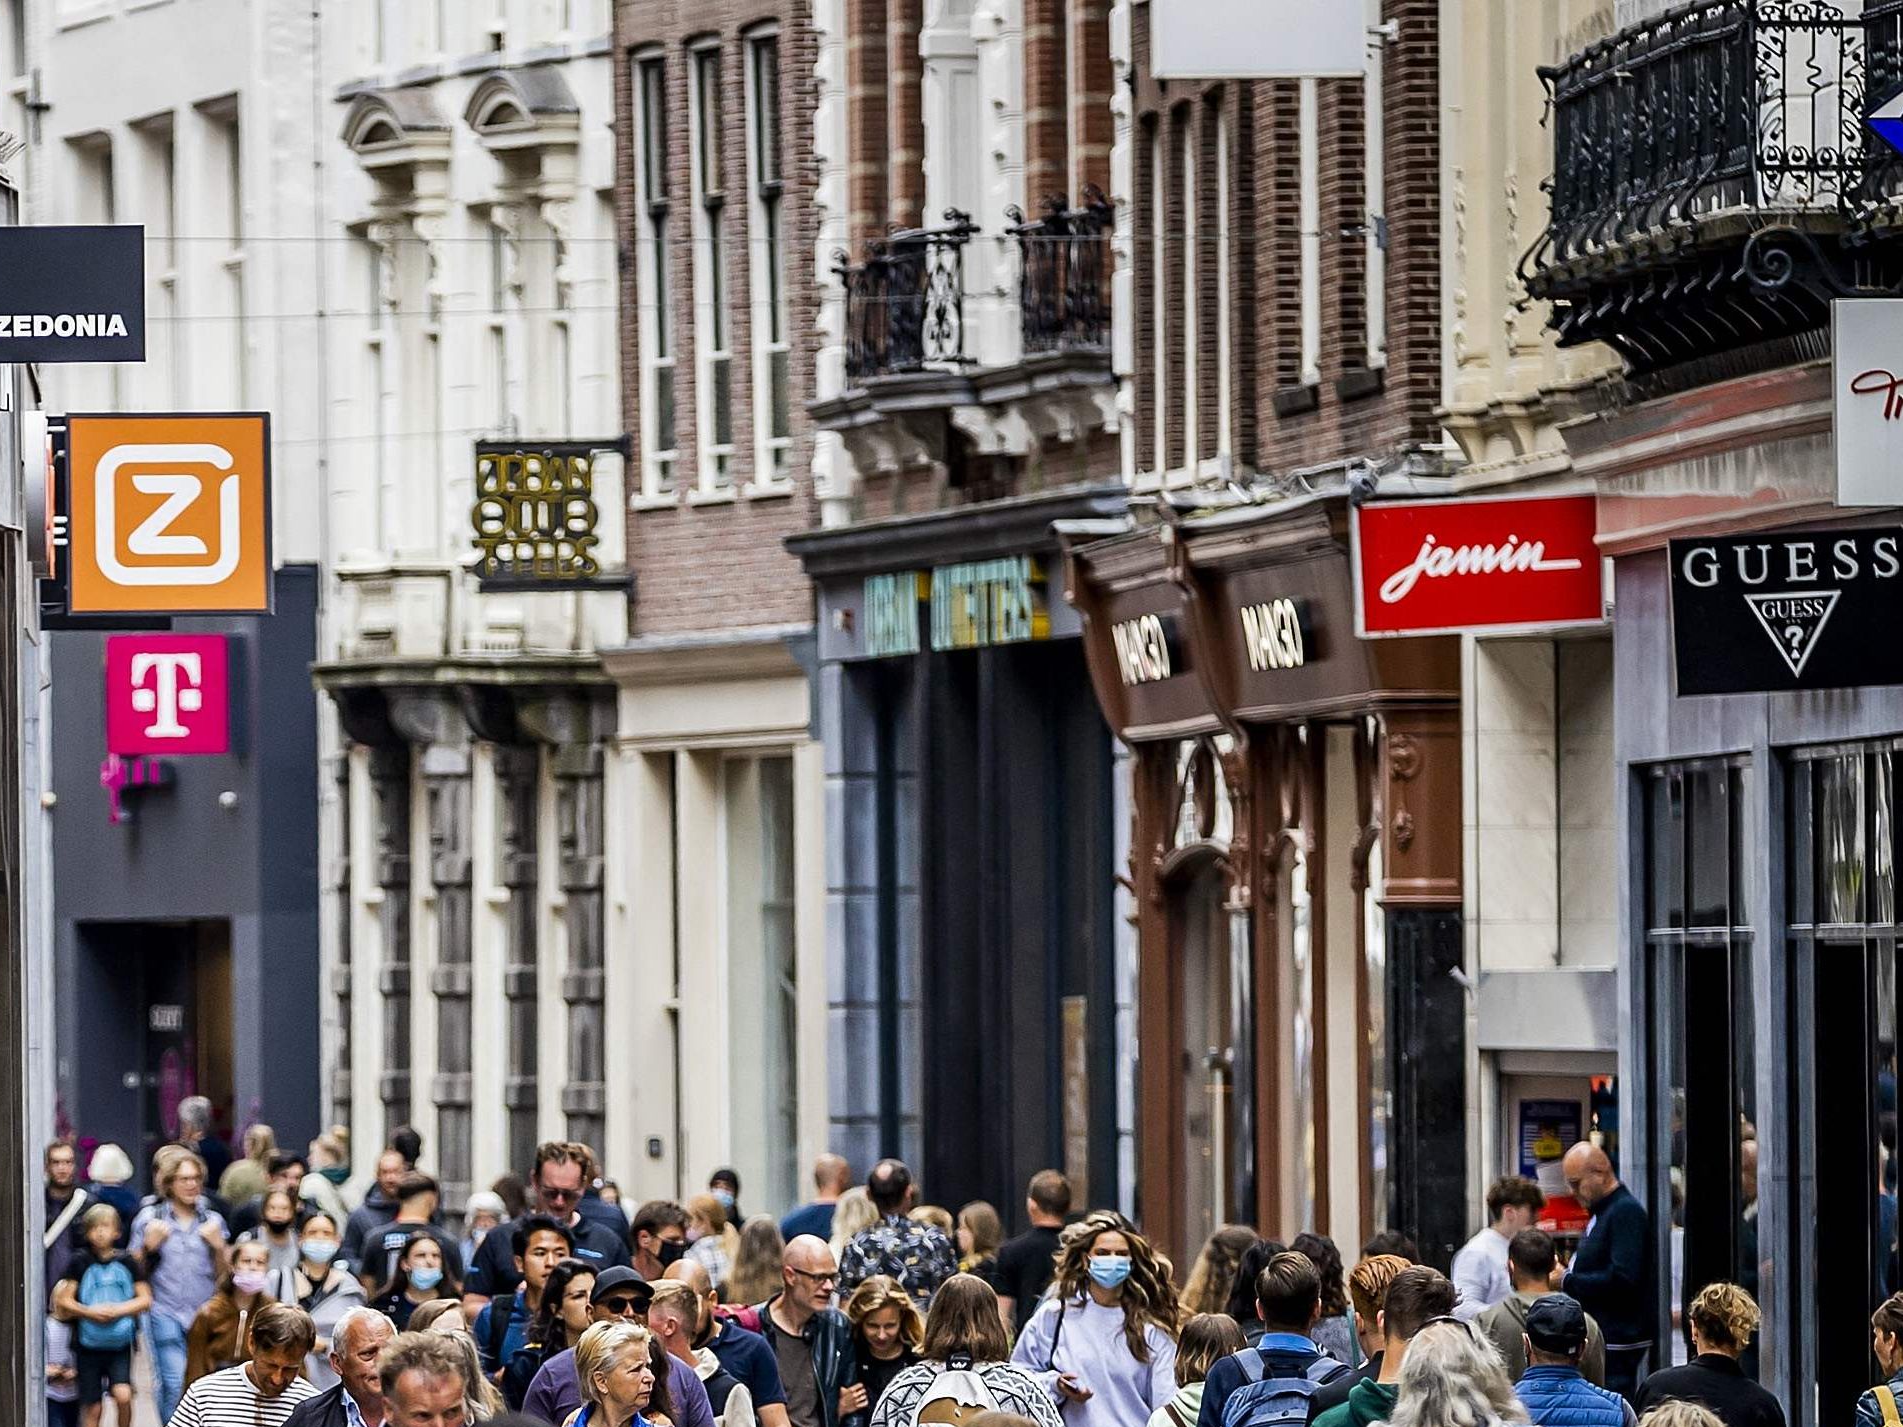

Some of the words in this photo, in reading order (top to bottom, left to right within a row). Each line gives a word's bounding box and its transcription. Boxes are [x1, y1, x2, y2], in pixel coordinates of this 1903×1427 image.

[1380, 534, 1582, 603] jamin
[1682, 537, 1900, 587] GUESS
[1761, 599, 1824, 619] GUESS
[131, 653, 202, 738] T
